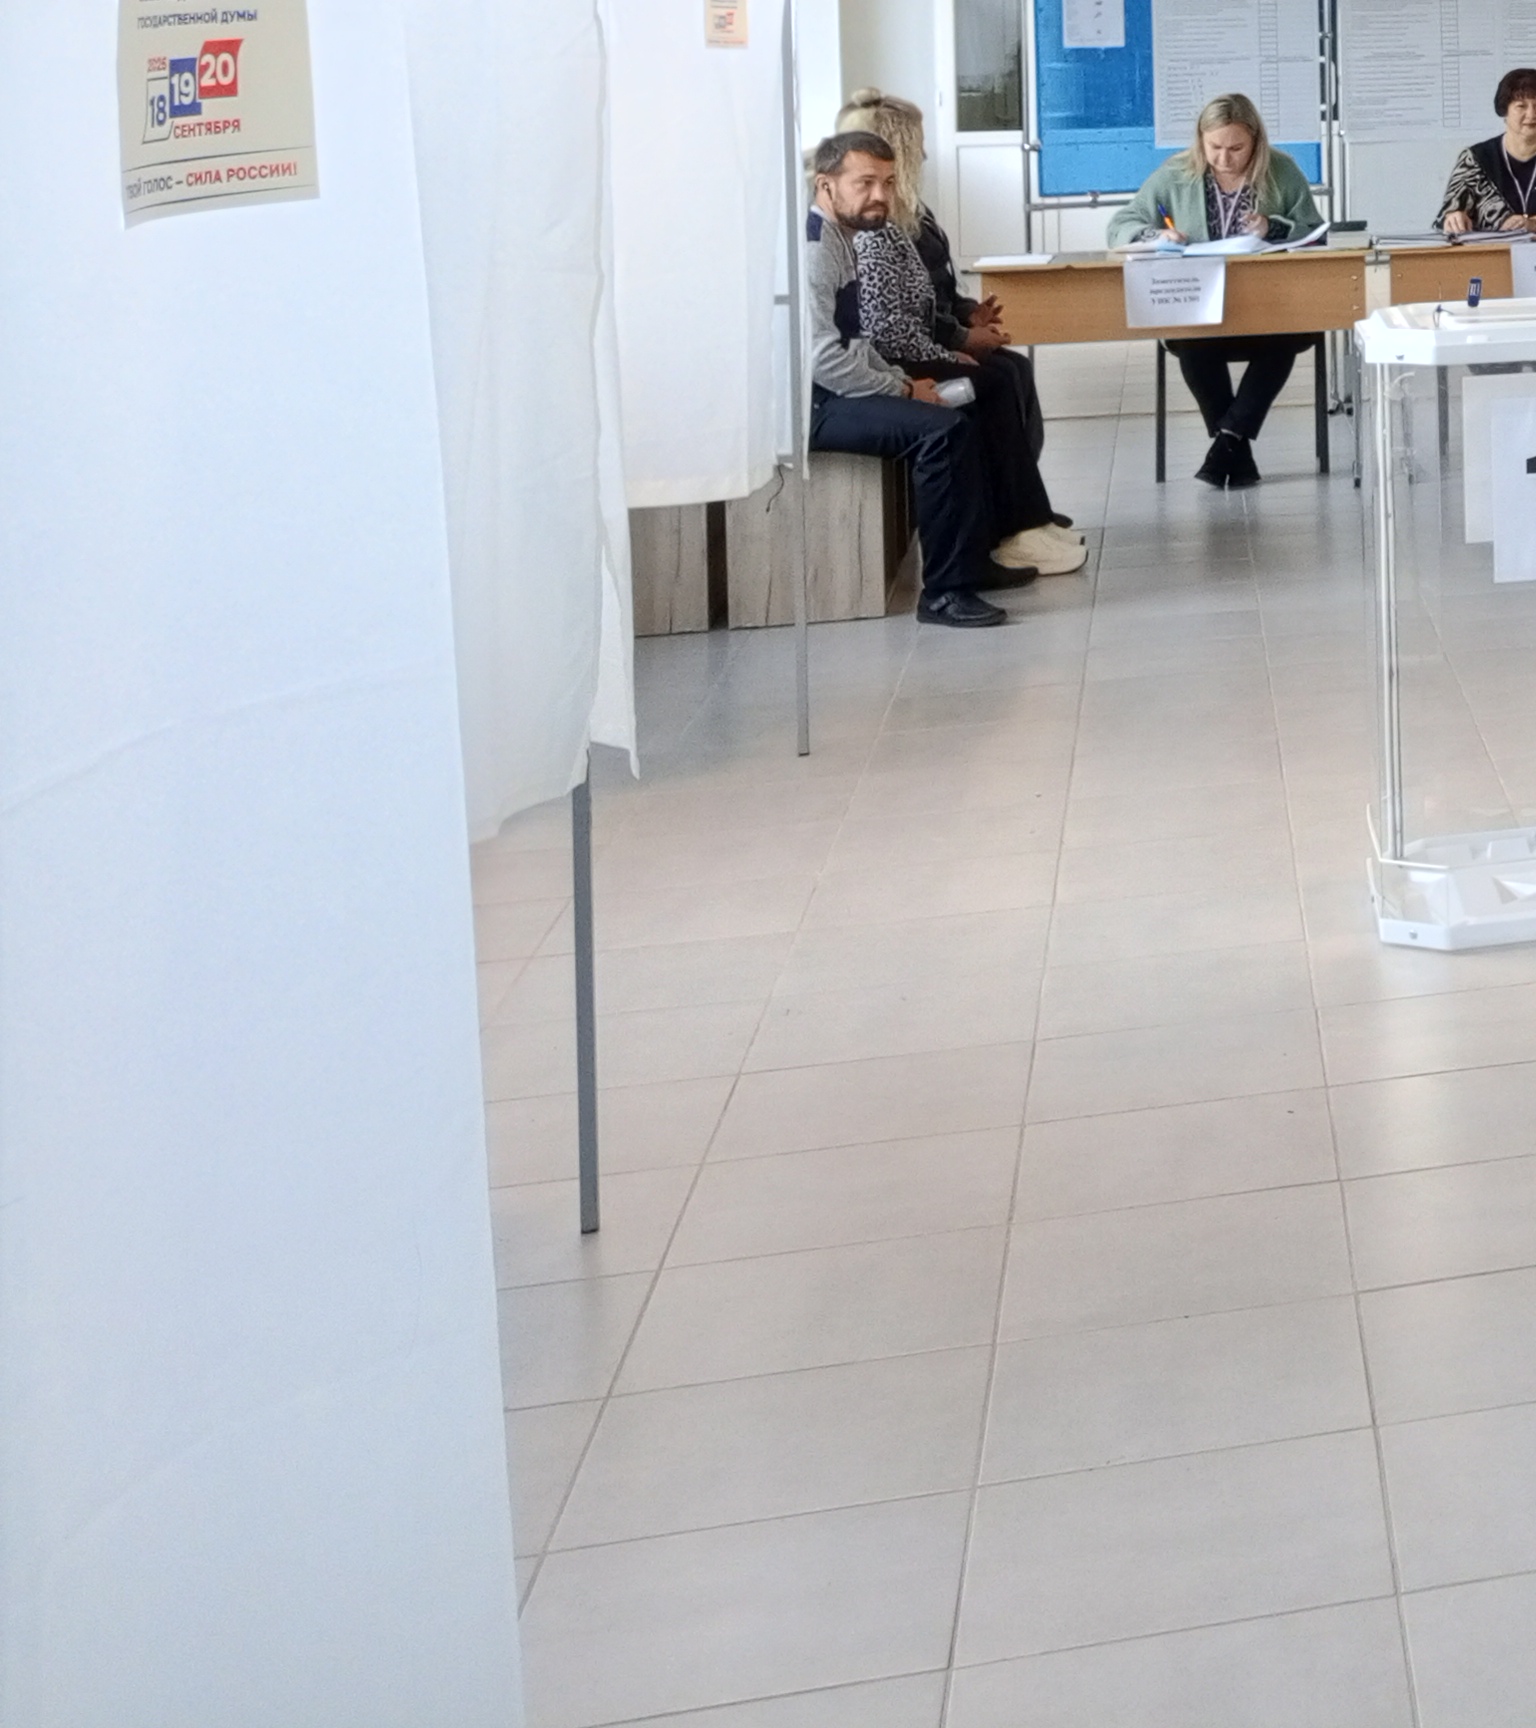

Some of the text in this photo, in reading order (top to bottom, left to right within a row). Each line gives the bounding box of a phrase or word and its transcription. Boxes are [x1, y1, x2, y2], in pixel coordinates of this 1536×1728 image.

[220, 10, 258, 26] ДУМЫ
[149, 52, 236, 128] 18 19 20
[173, 119, 241, 140] СЕНТЯБРЯ
[143, 175, 173, 195] ГОЛОС
[186, 169, 223, 187] СИЛА
[226, 162, 298, 183] РОССИИ!
